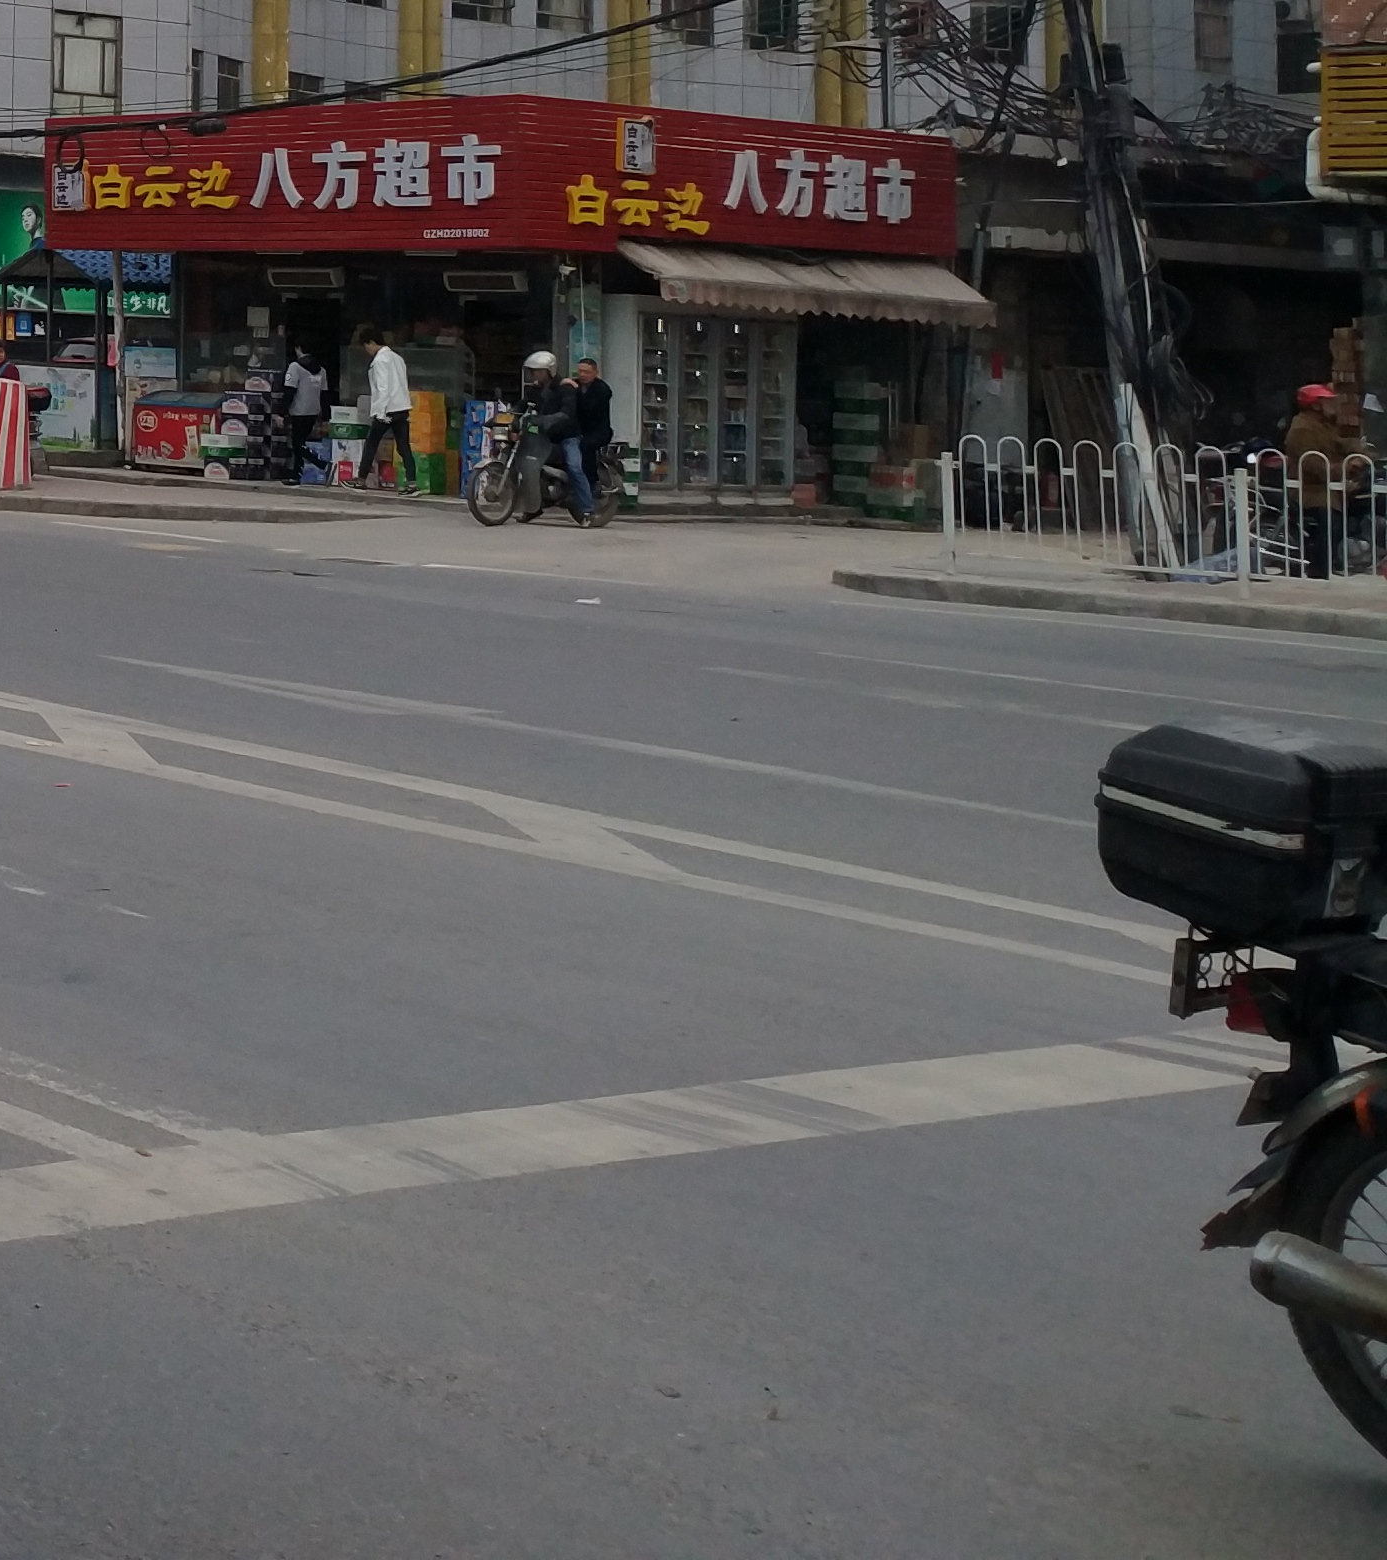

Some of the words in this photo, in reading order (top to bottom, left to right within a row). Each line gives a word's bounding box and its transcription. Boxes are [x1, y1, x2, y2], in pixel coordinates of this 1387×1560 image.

[93, 161, 241, 210] 白云边
[249, 134, 503, 211] 八方超市
[567, 174, 711, 236] 白云边
[724, 149, 916, 225] 八方超市
